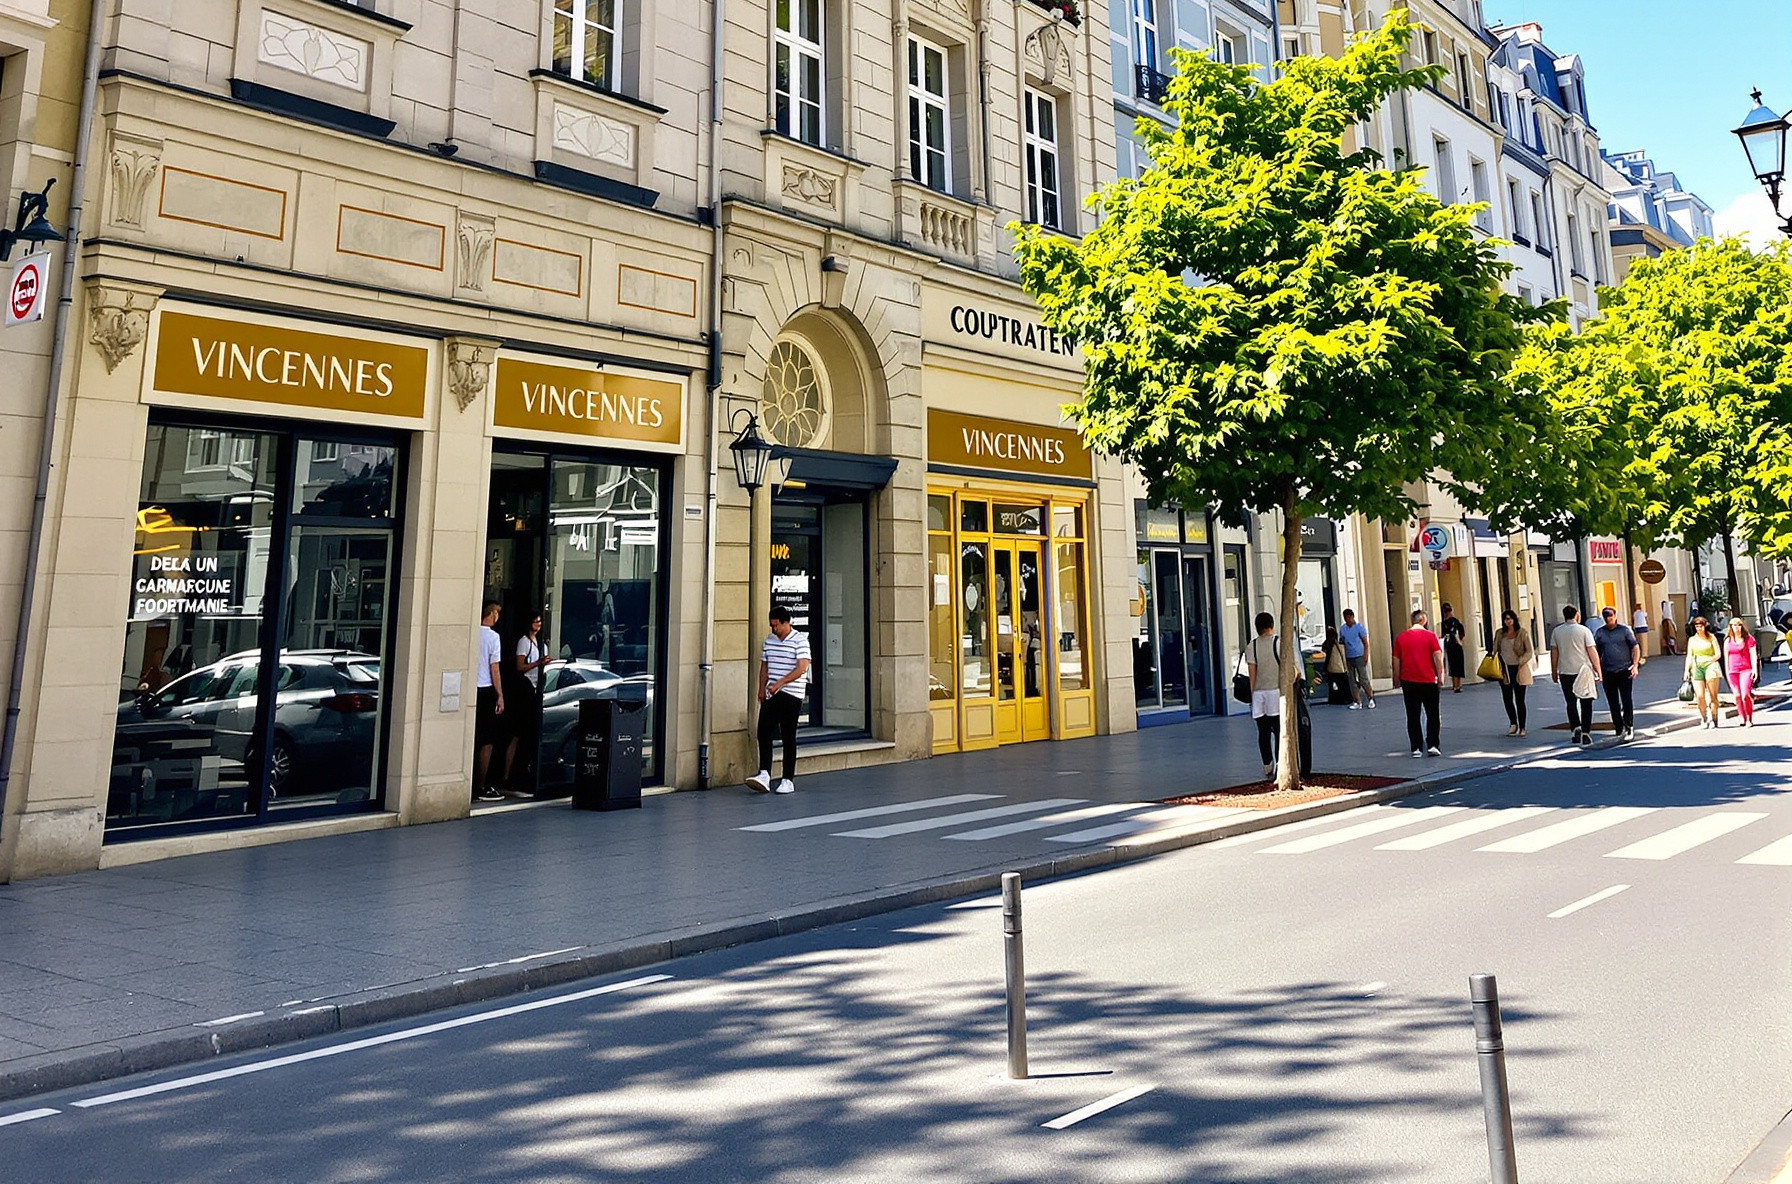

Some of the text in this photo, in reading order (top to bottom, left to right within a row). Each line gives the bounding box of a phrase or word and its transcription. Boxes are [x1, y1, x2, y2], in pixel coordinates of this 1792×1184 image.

[191, 337, 394, 397] VINCENNES
[521, 381, 663, 427] VINCENNES
[962, 428, 1065, 464] VINCENNES
[196, 557, 218, 572] UN
